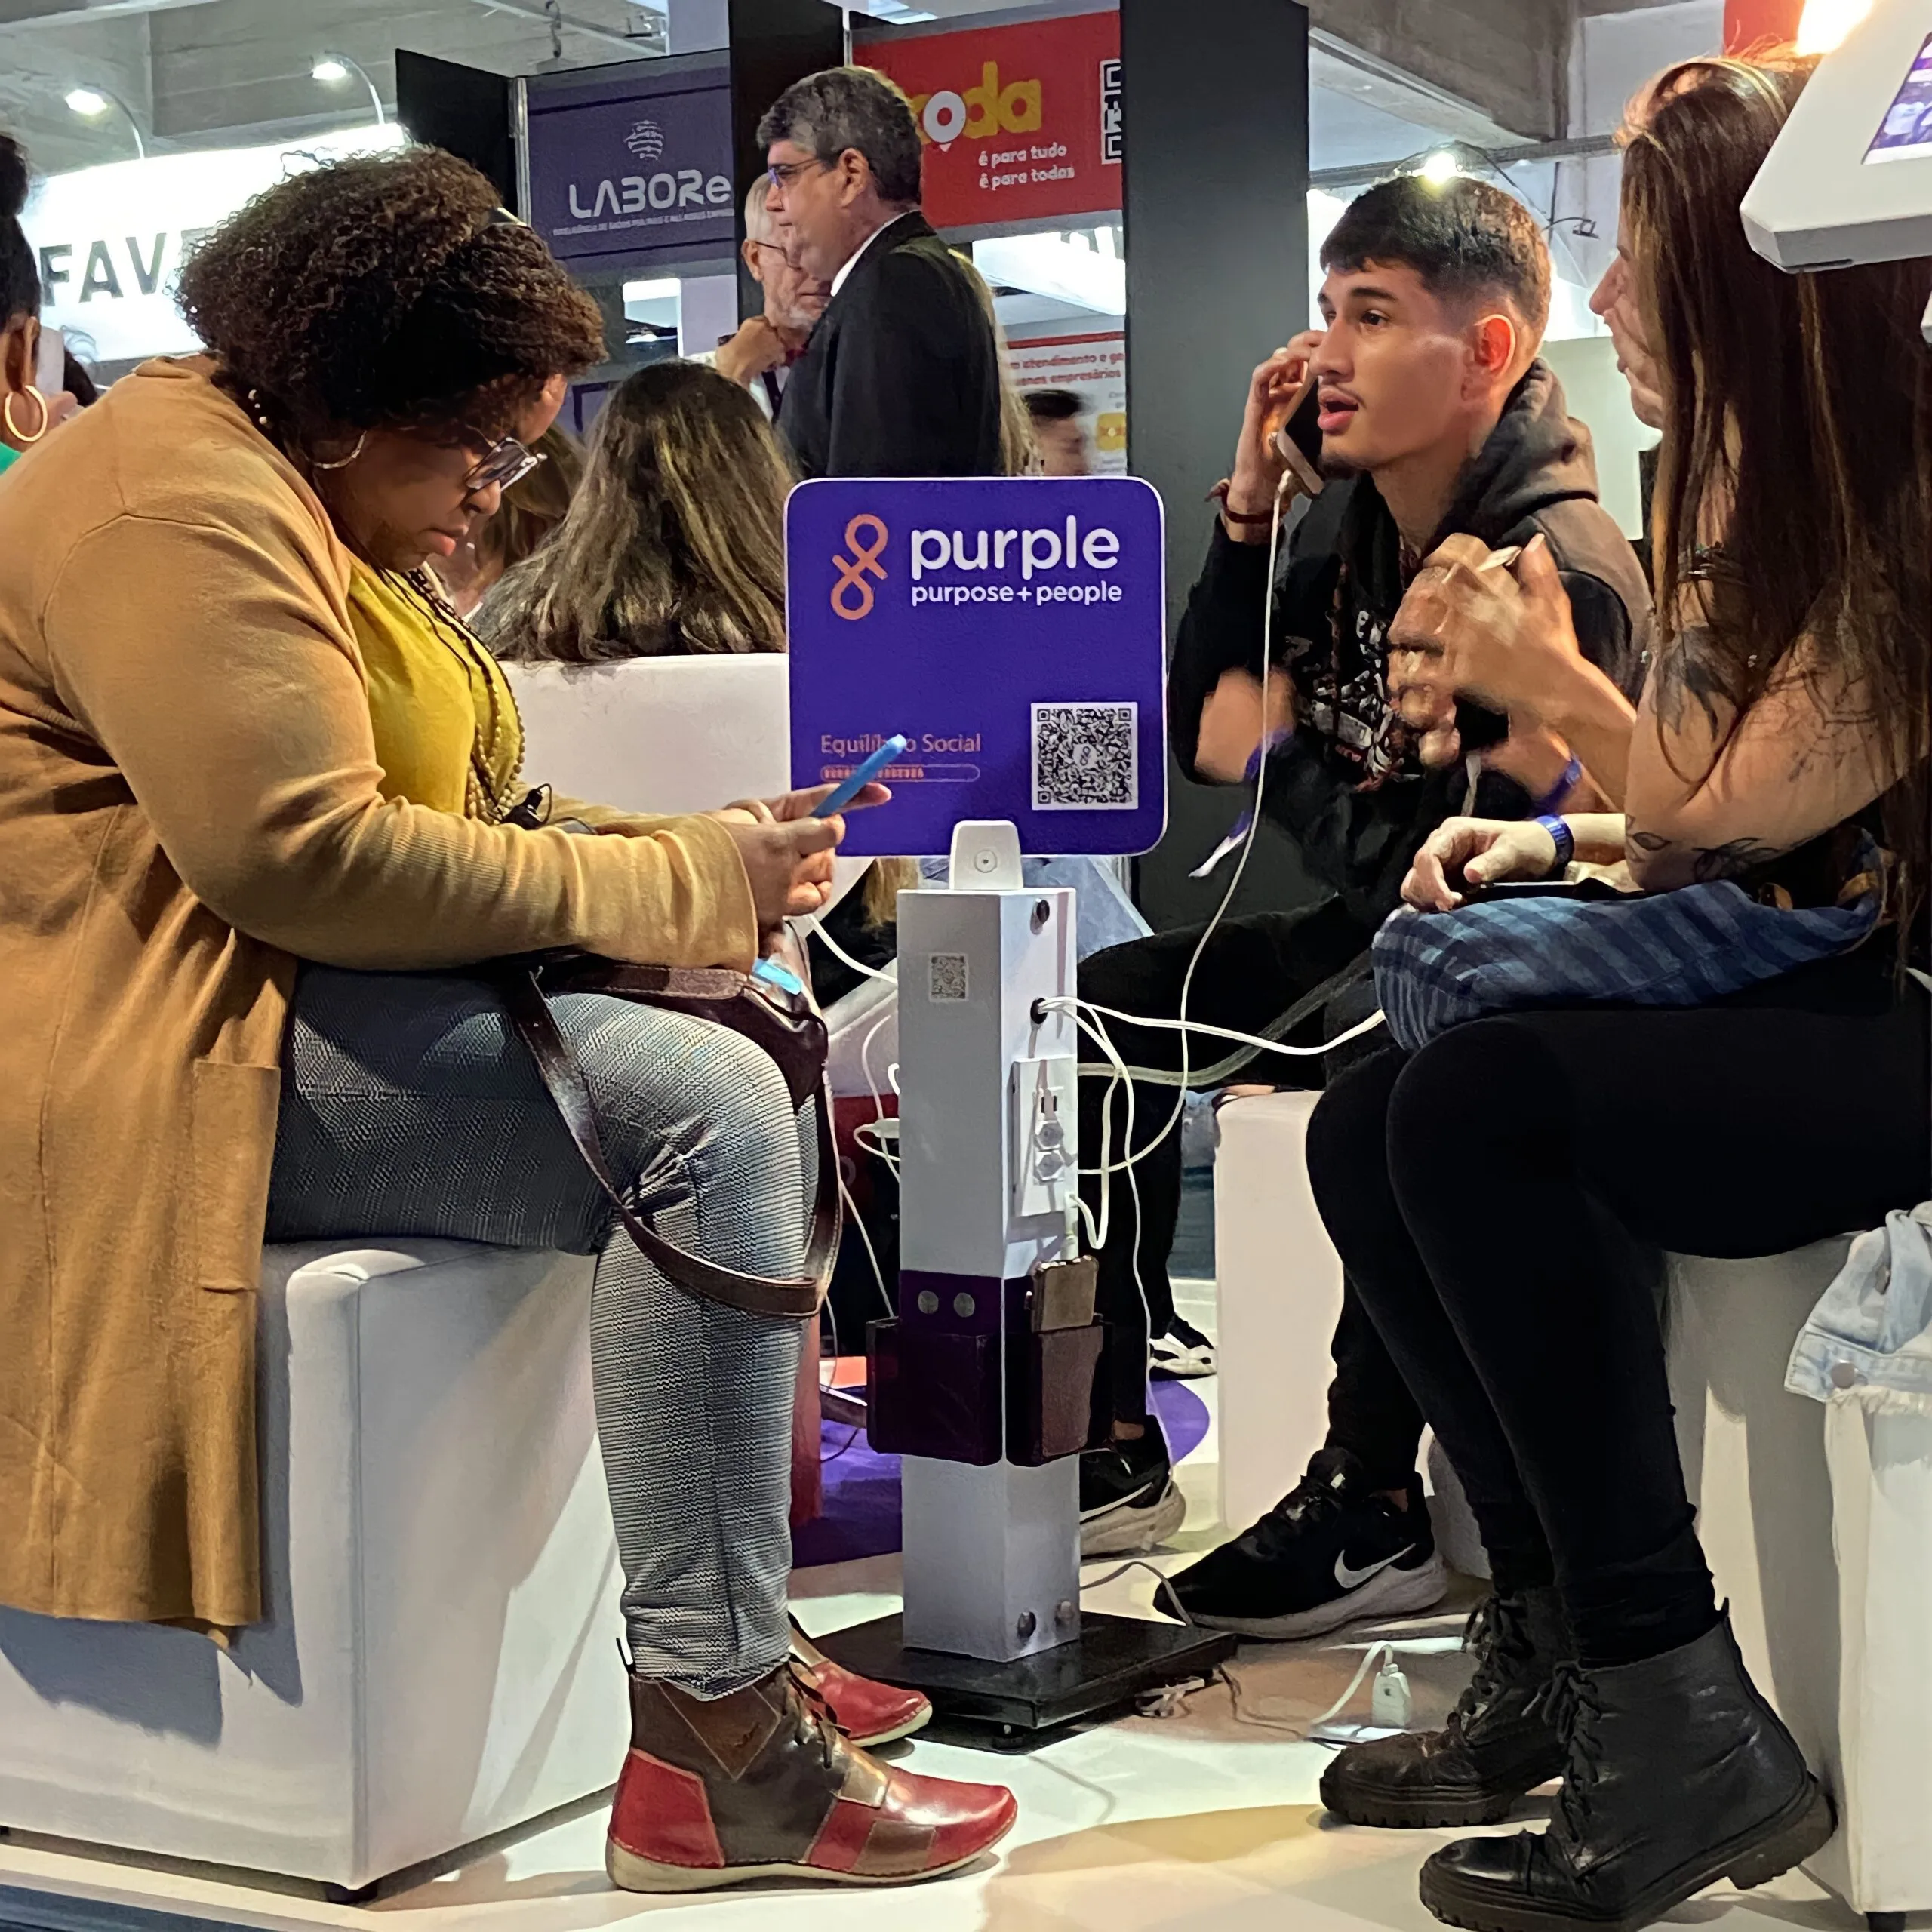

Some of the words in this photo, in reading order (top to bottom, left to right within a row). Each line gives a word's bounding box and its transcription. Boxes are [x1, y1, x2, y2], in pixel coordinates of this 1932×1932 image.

[991, 150, 1026, 168] para
[1031, 142, 1067, 159] tudo
[992, 172, 1027, 190] para
[911, 515, 1120, 580] purple
[912, 586, 1014, 606] purpose
[1036, 580, 1122, 606] people
[922, 733, 981, 752] Social
